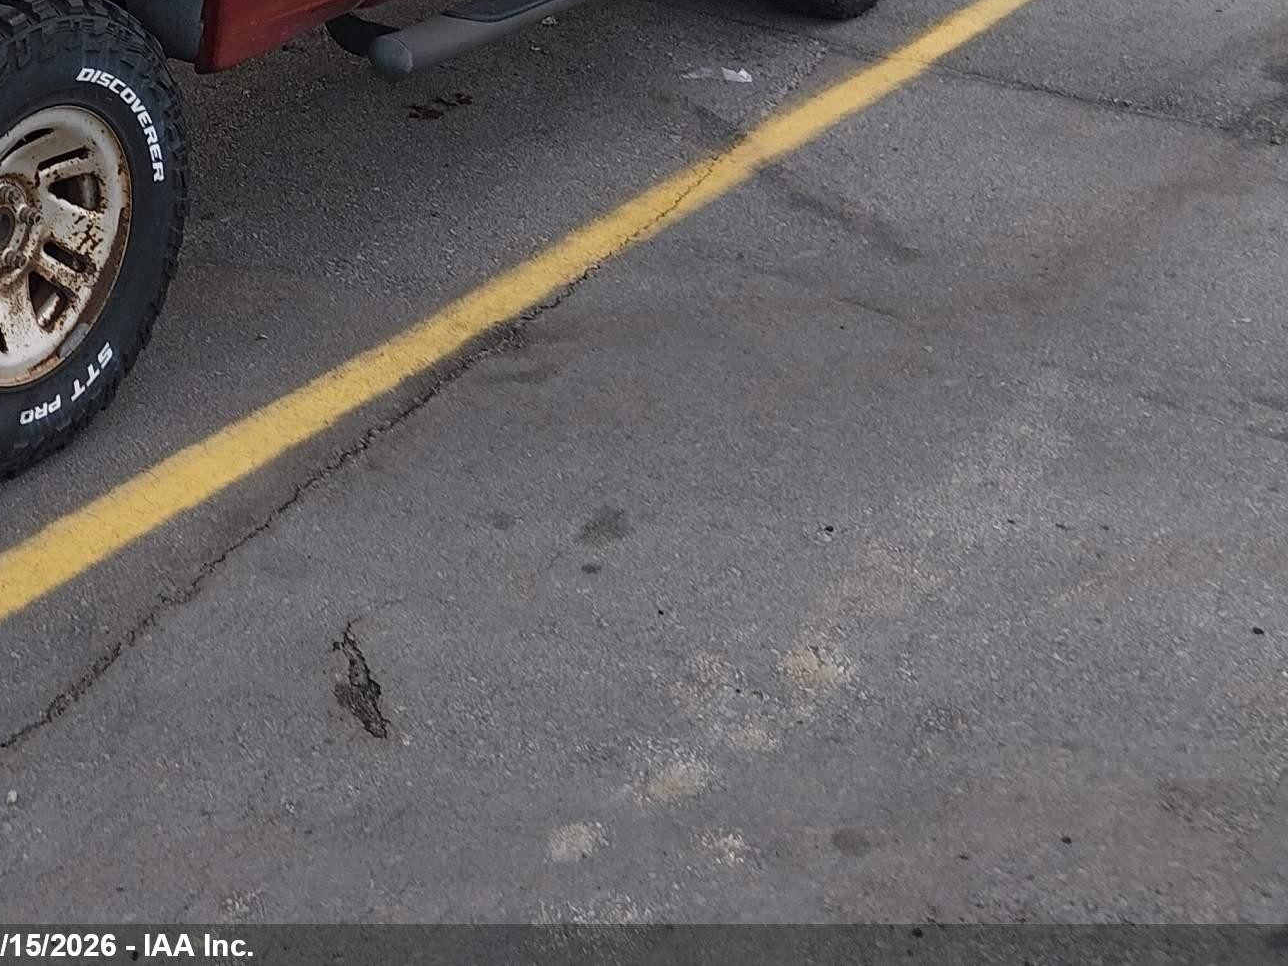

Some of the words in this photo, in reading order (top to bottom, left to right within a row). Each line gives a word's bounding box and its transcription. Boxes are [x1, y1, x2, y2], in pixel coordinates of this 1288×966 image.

[75, 67, 164, 183] DISCOVERER
[69, 341, 113, 403] STT
[19, 393, 62, 426] PRO
